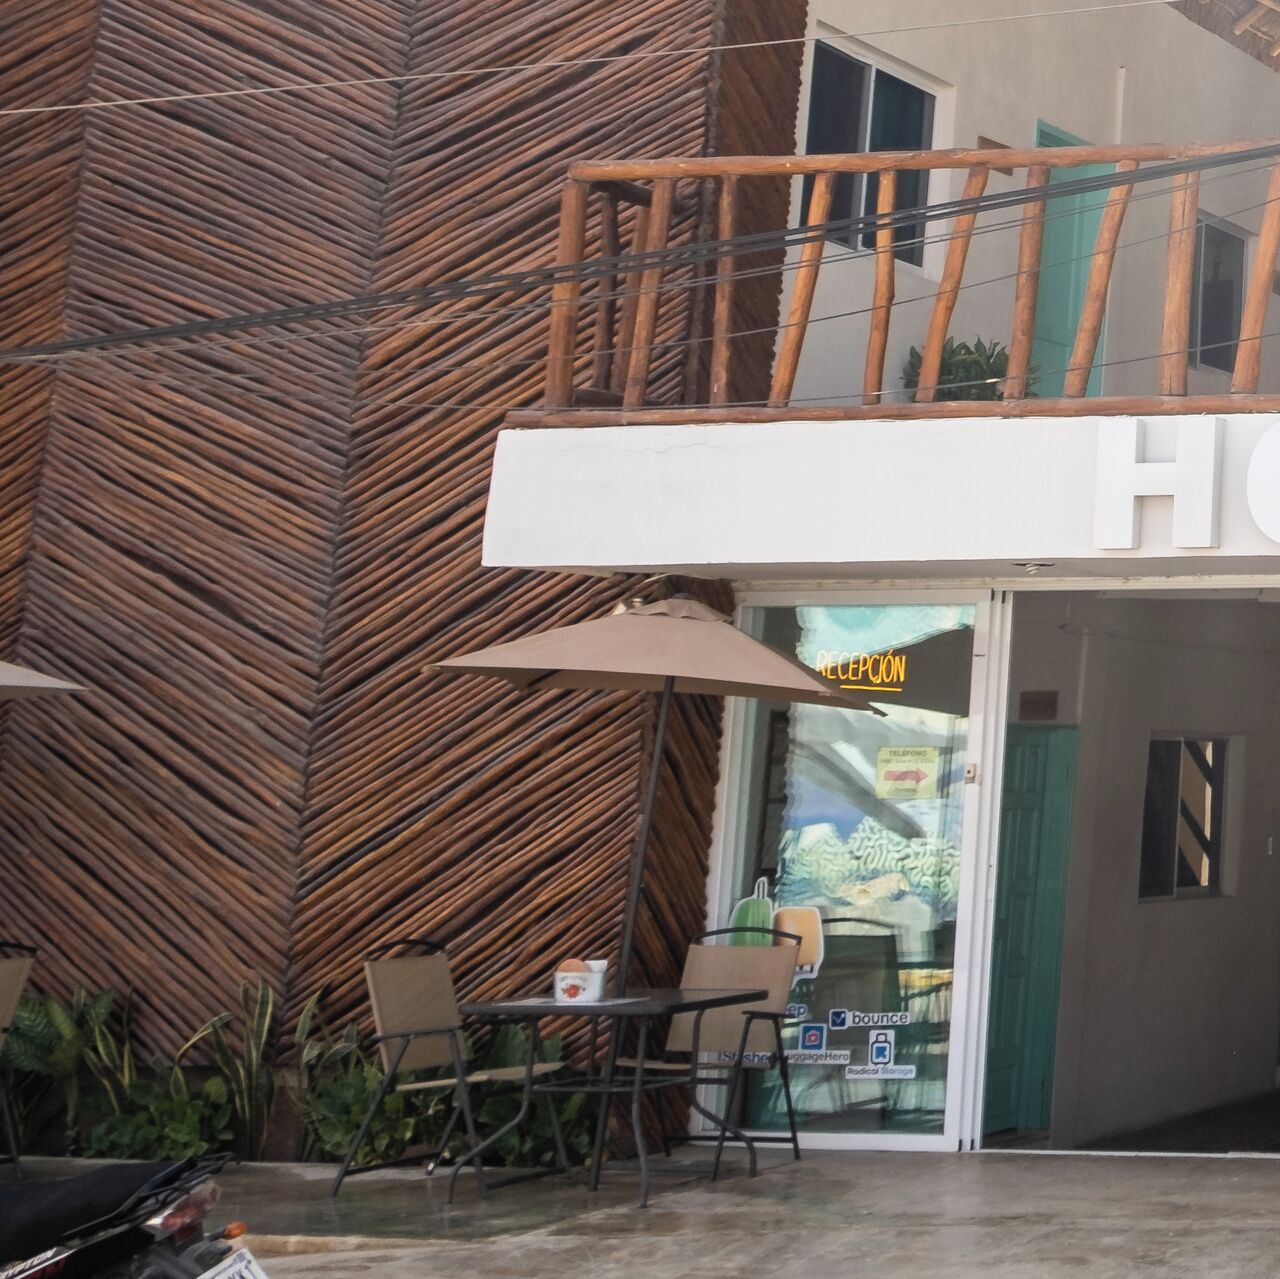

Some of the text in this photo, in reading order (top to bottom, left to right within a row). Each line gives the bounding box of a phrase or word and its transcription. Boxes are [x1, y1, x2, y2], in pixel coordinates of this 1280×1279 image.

[816, 648, 906, 684] RECEPCIÓN
[852, 1011, 908, 1025] bounce
[786, 1052, 849, 1063] uggageHero
